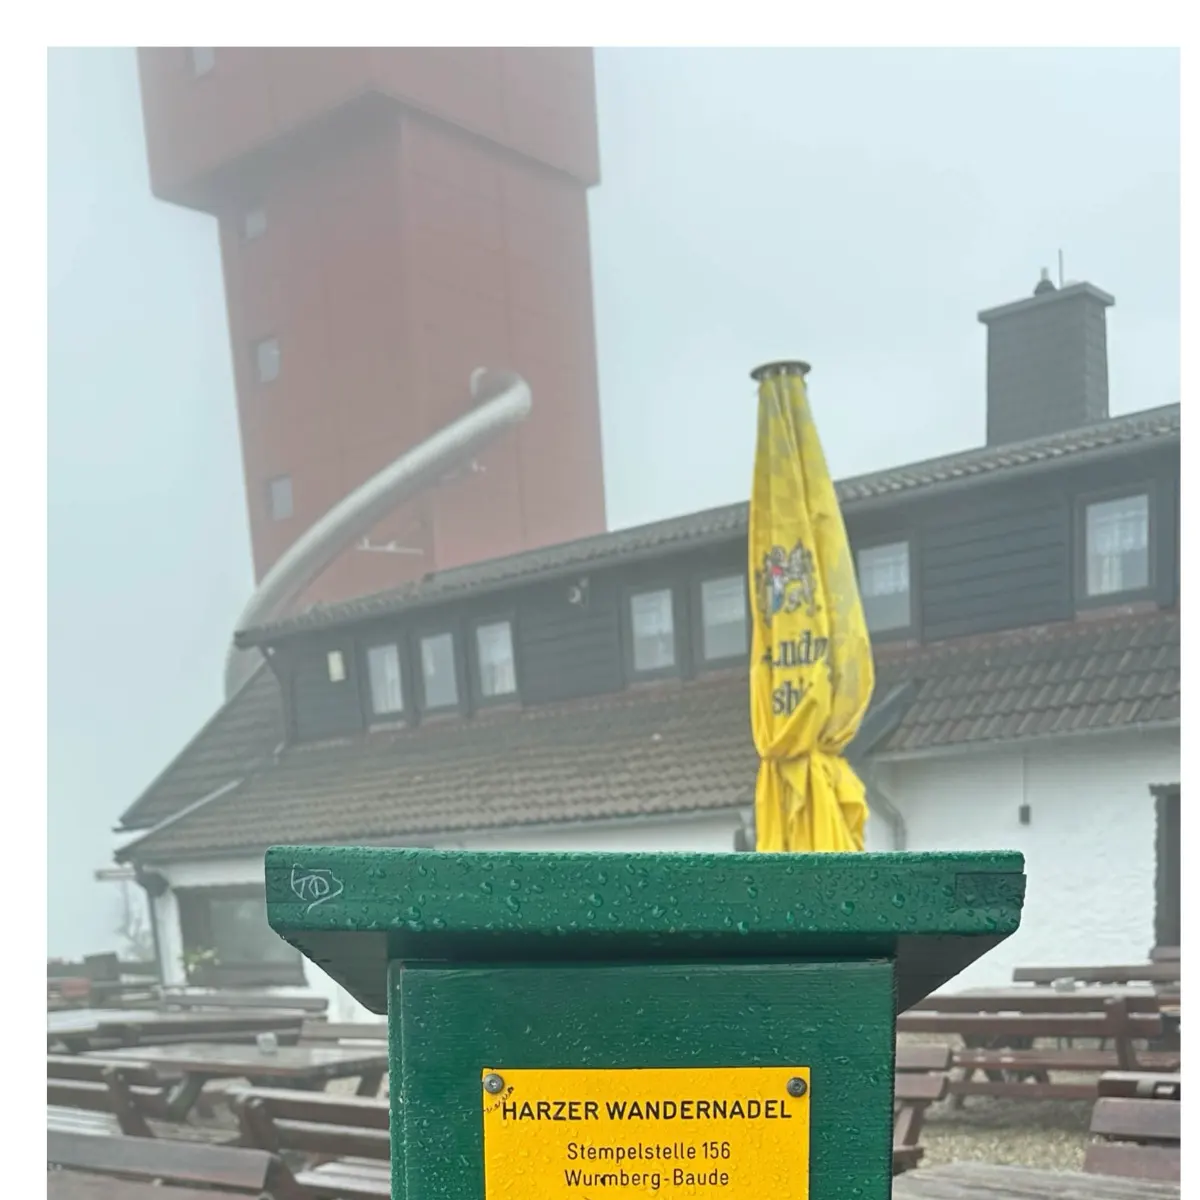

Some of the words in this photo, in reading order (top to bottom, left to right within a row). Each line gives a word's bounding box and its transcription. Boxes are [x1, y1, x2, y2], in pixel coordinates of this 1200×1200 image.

[502, 1101, 600, 1121] HARZER
[605, 1099, 792, 1119] WANDERNADEL
[566, 1142, 697, 1161] Stempelstelle
[701, 1141, 731, 1160] 156
